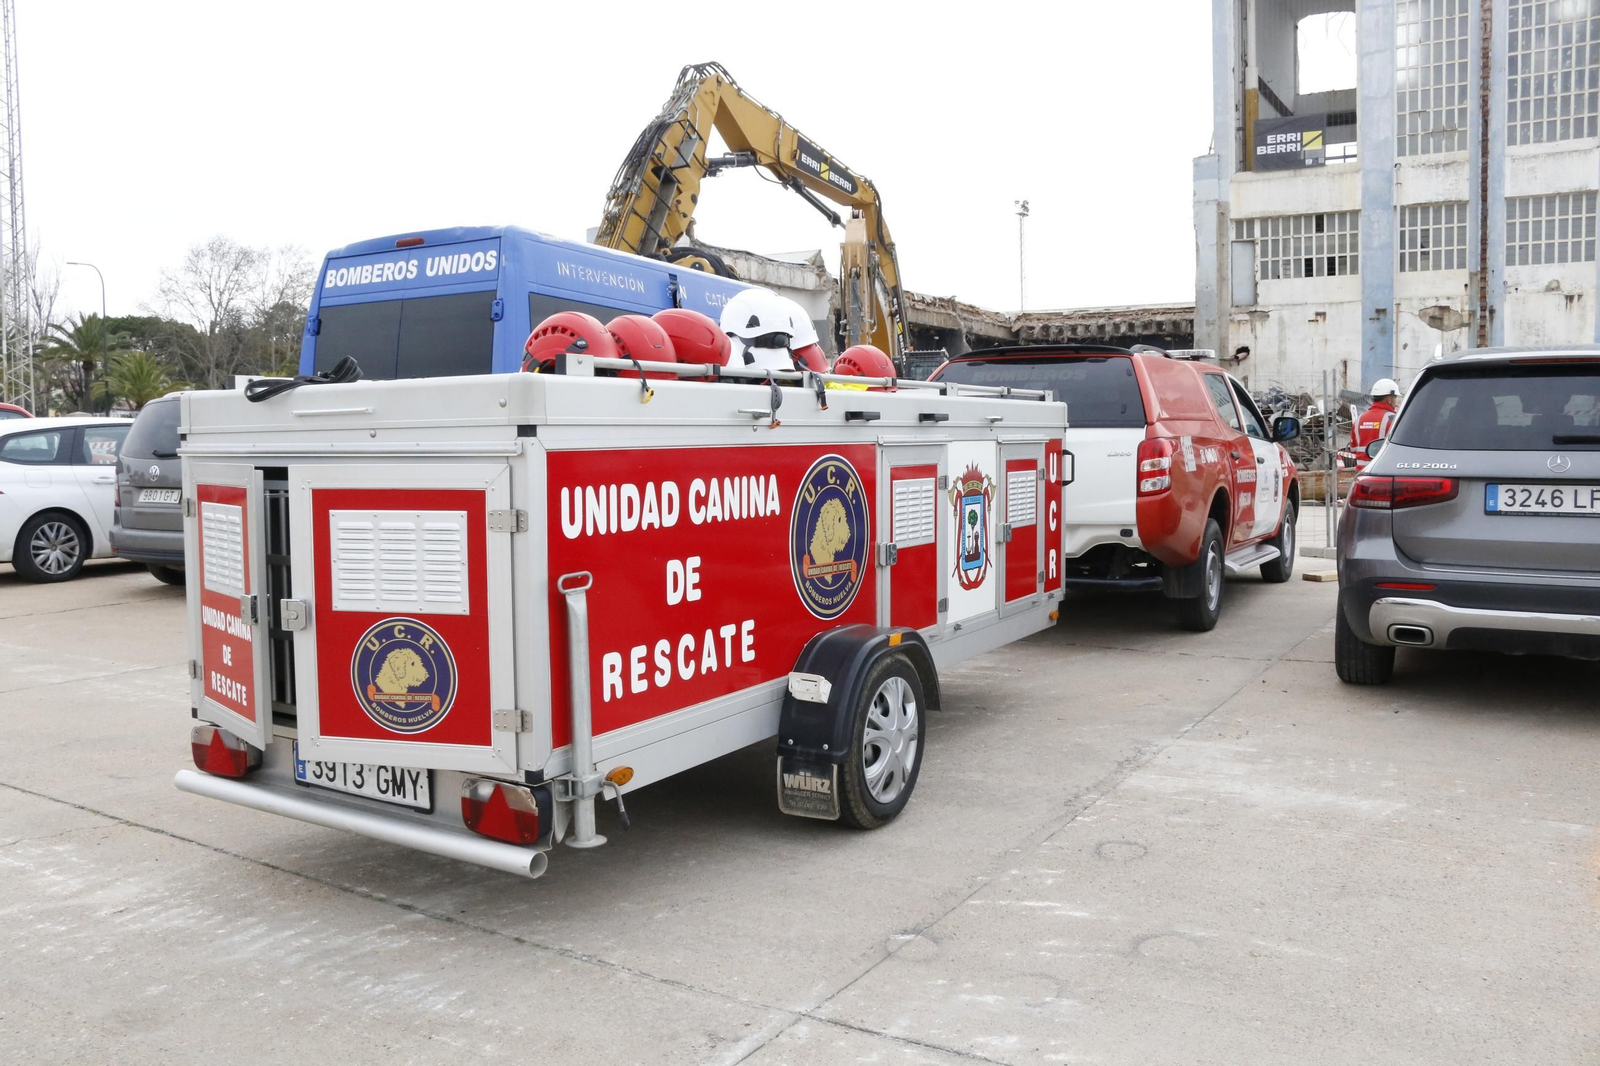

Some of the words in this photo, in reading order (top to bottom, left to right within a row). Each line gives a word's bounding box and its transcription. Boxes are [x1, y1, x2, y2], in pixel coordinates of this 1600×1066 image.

[1256, 143, 1301, 155] BERRI
[1266, 132, 1301, 144] ERRI
[801, 153, 820, 172] ERRI
[829, 171, 852, 192] BERRI
[325, 260, 418, 289] BOMBEROS
[425, 250, 498, 277] UNIDOS
[556, 260, 645, 293] INTERVENCIÓN
[972, 369, 1088, 382] BOMBEROS
[1396, 462, 1421, 470] GLB
[560, 480, 680, 539] UNIDAD
[688, 473, 781, 525] CANINA
[1504, 488, 1564, 508] 3246
[666, 555, 702, 606] DE
[805, 580, 832, 605] BOMBEROS
[832, 581, 853, 604] HUELVA
[202, 605, 226, 632] UNIDAD
[226, 613, 252, 642] CANINA
[222, 644, 232, 667] DE
[603, 619, 756, 703] RESCATE
[211, 670, 248, 707] RESCATE
[371, 702, 407, 724] BOMBEROS
[408, 709, 434, 724] HUELVA
[312, 760, 365, 789] 3913
[376, 765, 421, 800] GMY
